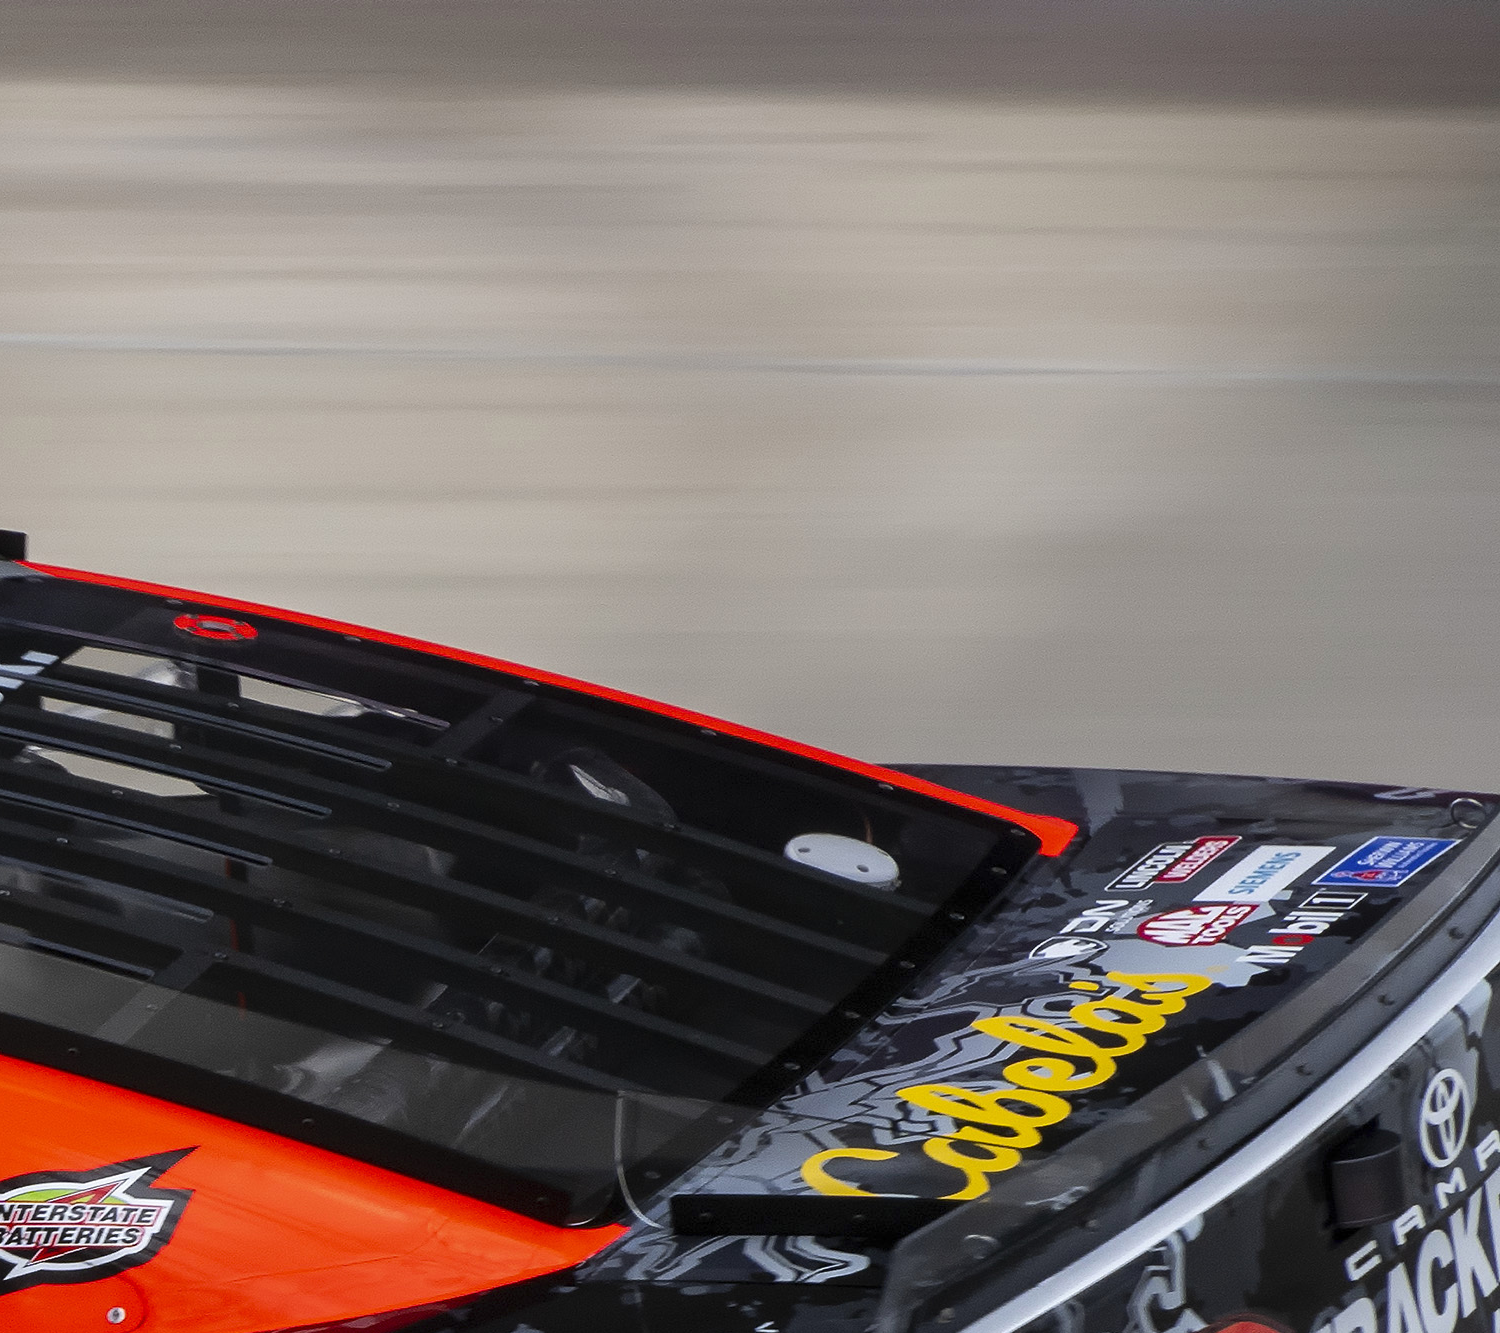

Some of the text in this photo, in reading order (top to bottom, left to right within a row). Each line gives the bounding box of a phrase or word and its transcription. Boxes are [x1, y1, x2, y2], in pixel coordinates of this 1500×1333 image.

[1116, 844, 1192, 889] LINCOLN
[1163, 839, 1230, 880] WELDERS
[1227, 851, 1302, 895] SIEMENS
[1149, 904, 1231, 945] MAC
[1189, 904, 1252, 945] TOOLS
[1236, 911, 1353, 965] Mobil
[800, 971, 1213, 1200] Cabela's
